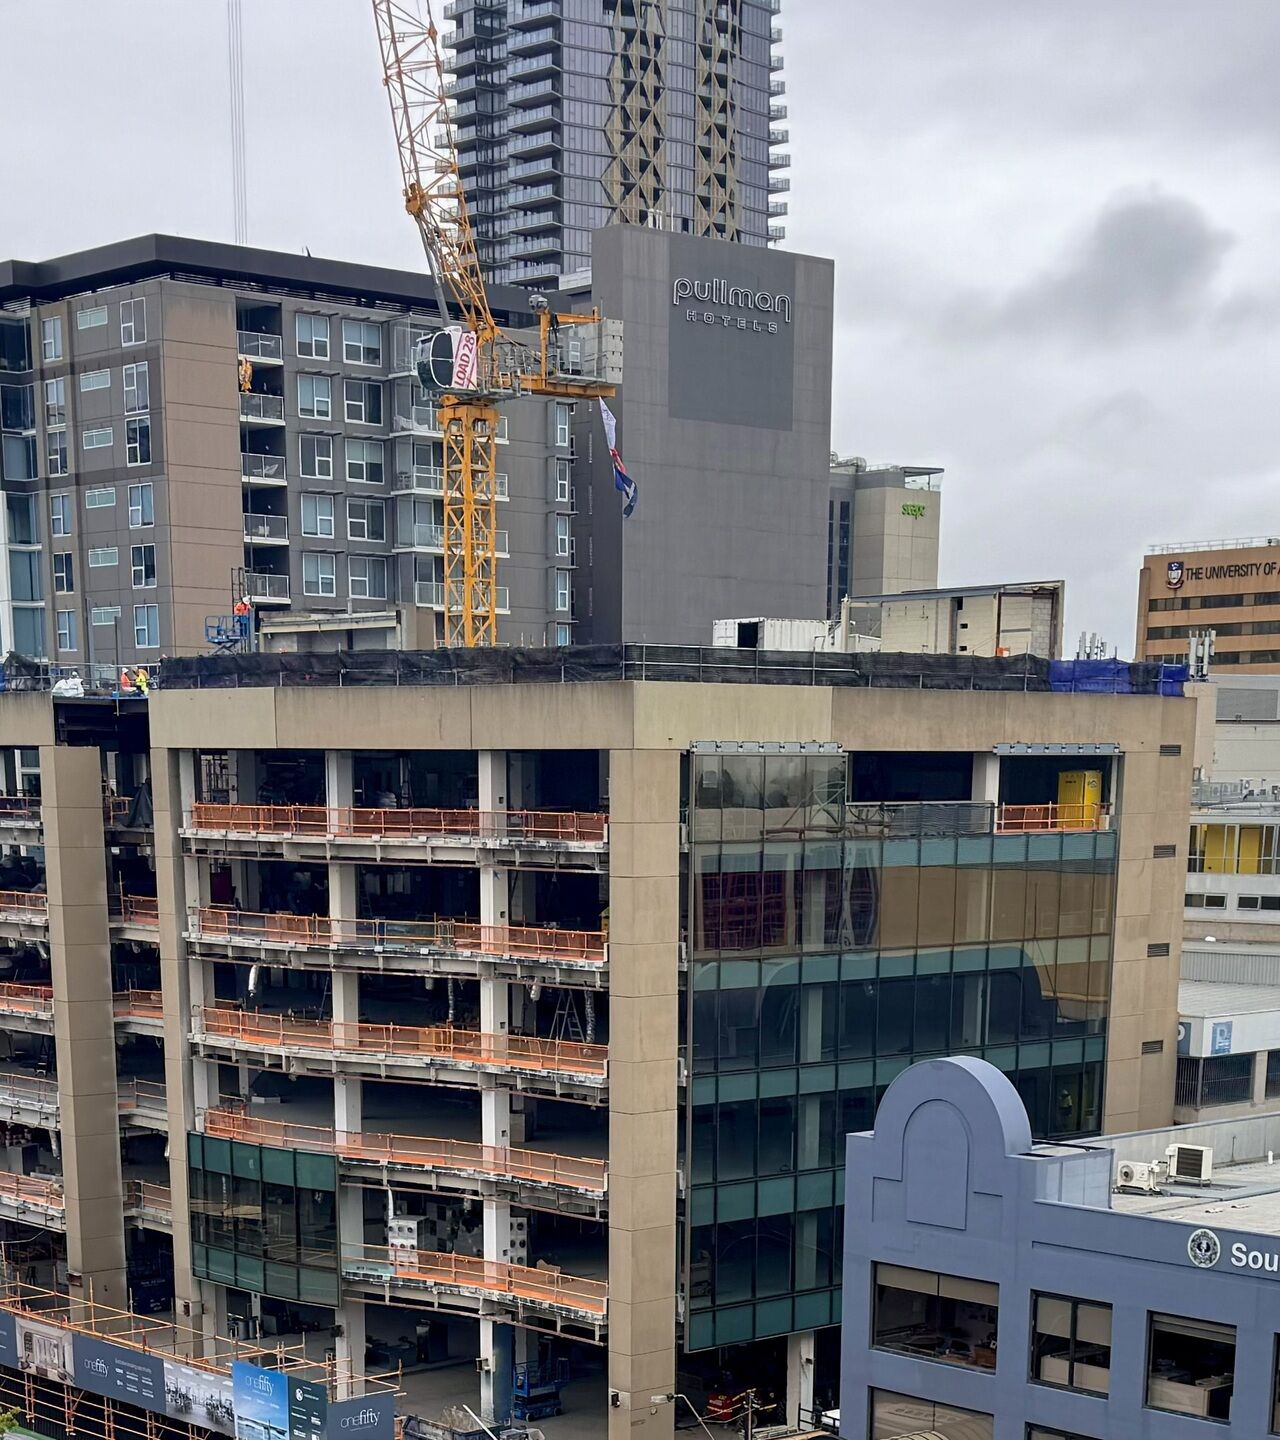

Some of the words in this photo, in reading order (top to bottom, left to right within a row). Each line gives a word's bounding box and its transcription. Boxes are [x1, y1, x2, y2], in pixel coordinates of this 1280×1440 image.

[673, 278, 791, 322] pullman
[686, 309, 777, 334] HOTELS
[454, 353, 470, 387] LOAD
[463, 335, 475, 353] 28
[1186, 567, 1203, 580] THE
[1205, 562, 1262, 580] UNIVERSITY
[1263, 562, 1277, 575] OF
[340, 1408, 381, 1428] onefifty
